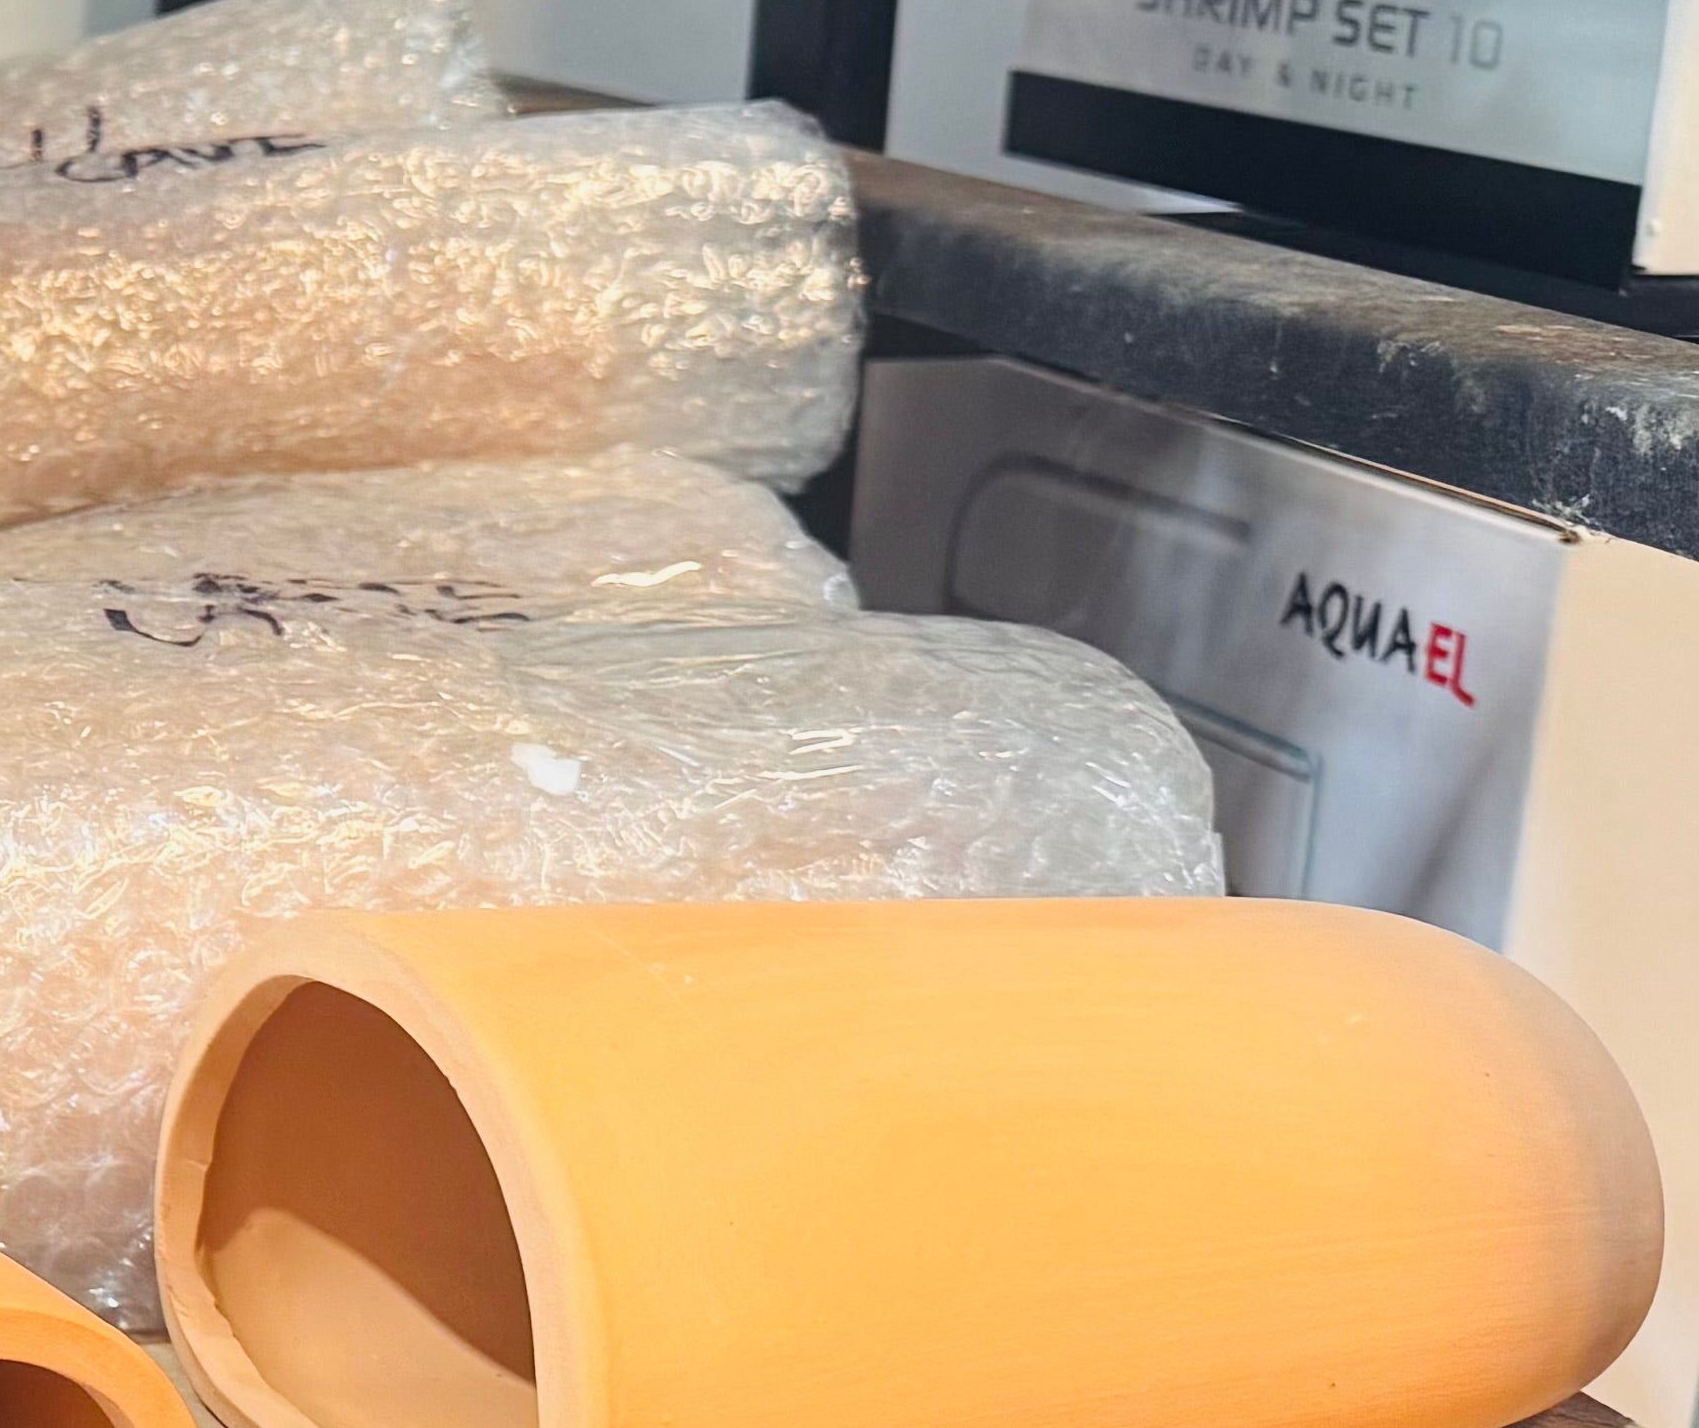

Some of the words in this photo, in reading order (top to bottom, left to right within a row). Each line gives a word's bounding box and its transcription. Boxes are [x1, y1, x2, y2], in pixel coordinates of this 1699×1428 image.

[1446, 11, 1504, 70] 10
[1309, 68, 1421, 112] NIGHT
[1279, 570, 1477, 709] AQUAEL
